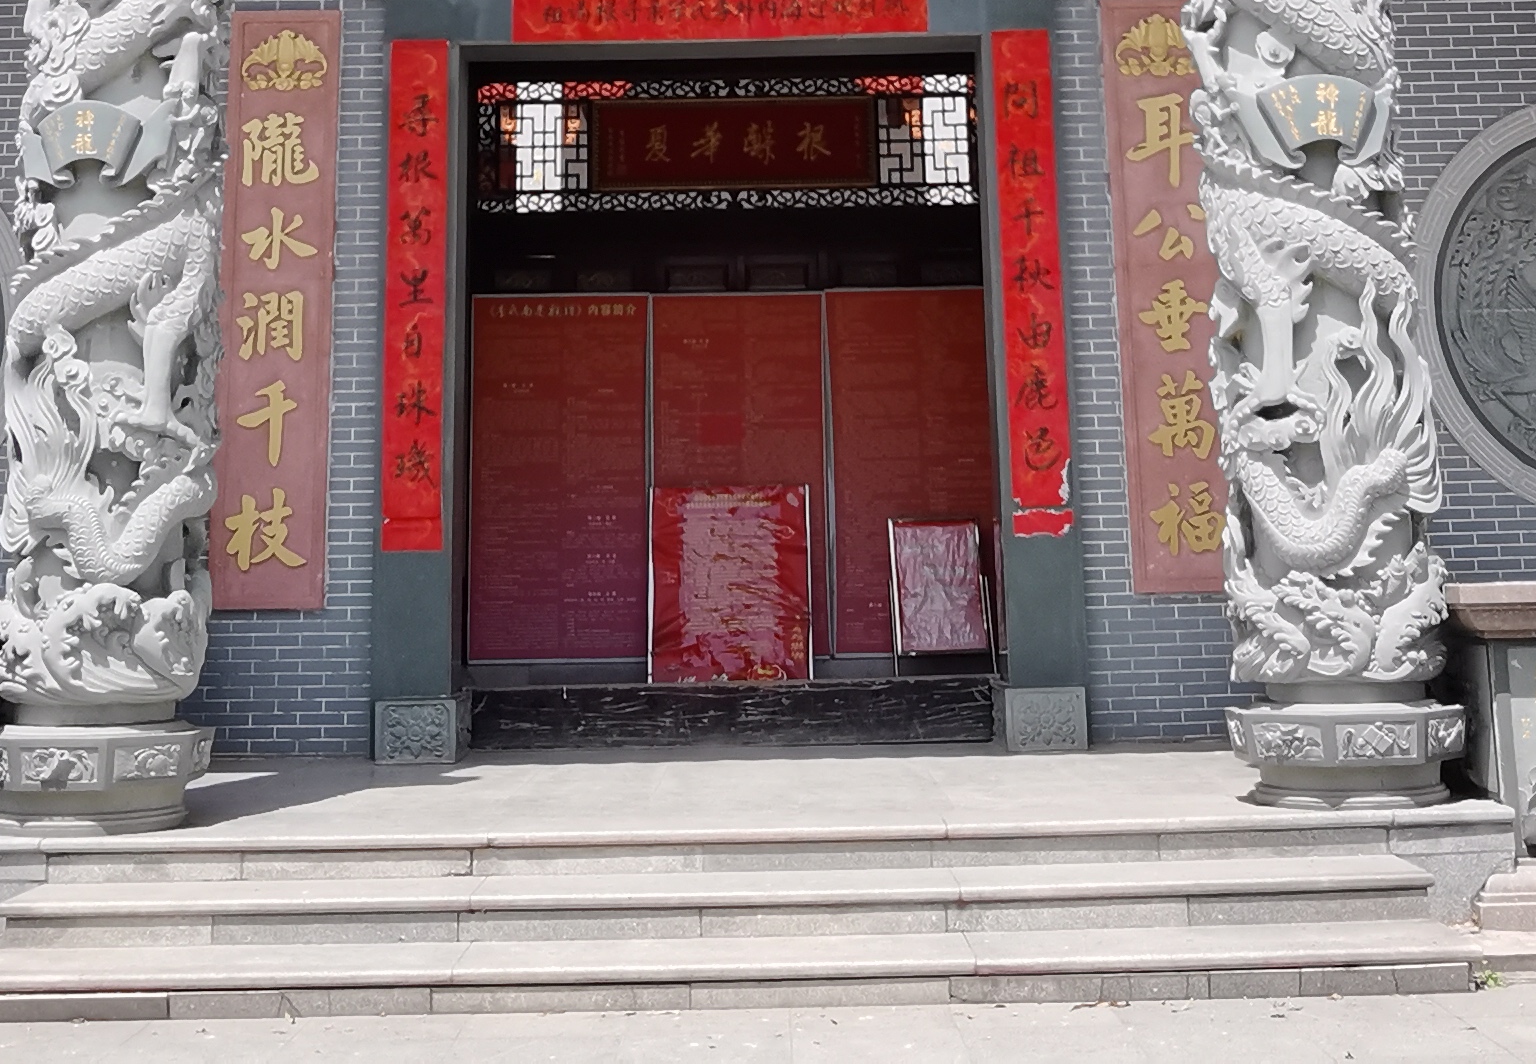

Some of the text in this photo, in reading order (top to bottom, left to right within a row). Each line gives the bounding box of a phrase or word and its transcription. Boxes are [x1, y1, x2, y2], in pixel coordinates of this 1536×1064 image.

[224, 112, 319, 572] 隴水潤千枝
